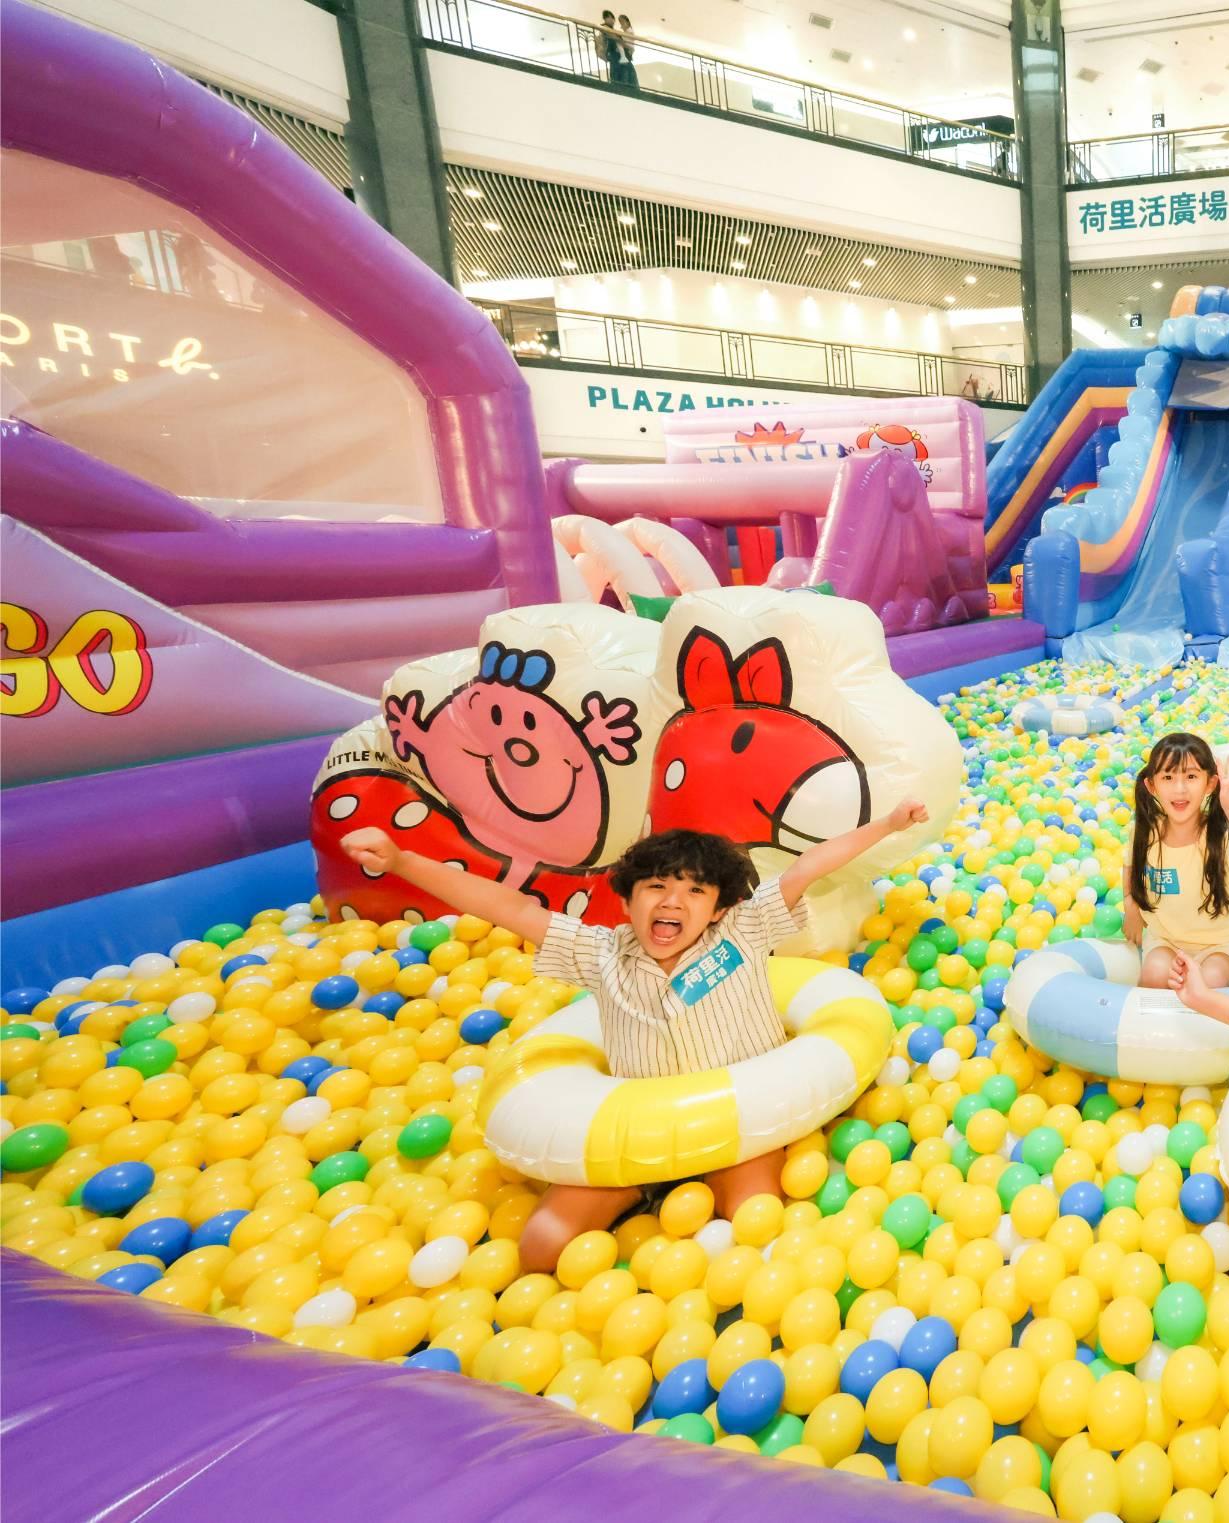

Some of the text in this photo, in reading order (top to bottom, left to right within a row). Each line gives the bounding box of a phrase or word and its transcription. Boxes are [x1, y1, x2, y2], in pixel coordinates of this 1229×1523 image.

[1079, 190, 1228, 234] 荷里活廣場
[588, 385, 696, 413] PLAZA
[326, 750, 370, 770] LITTLE
